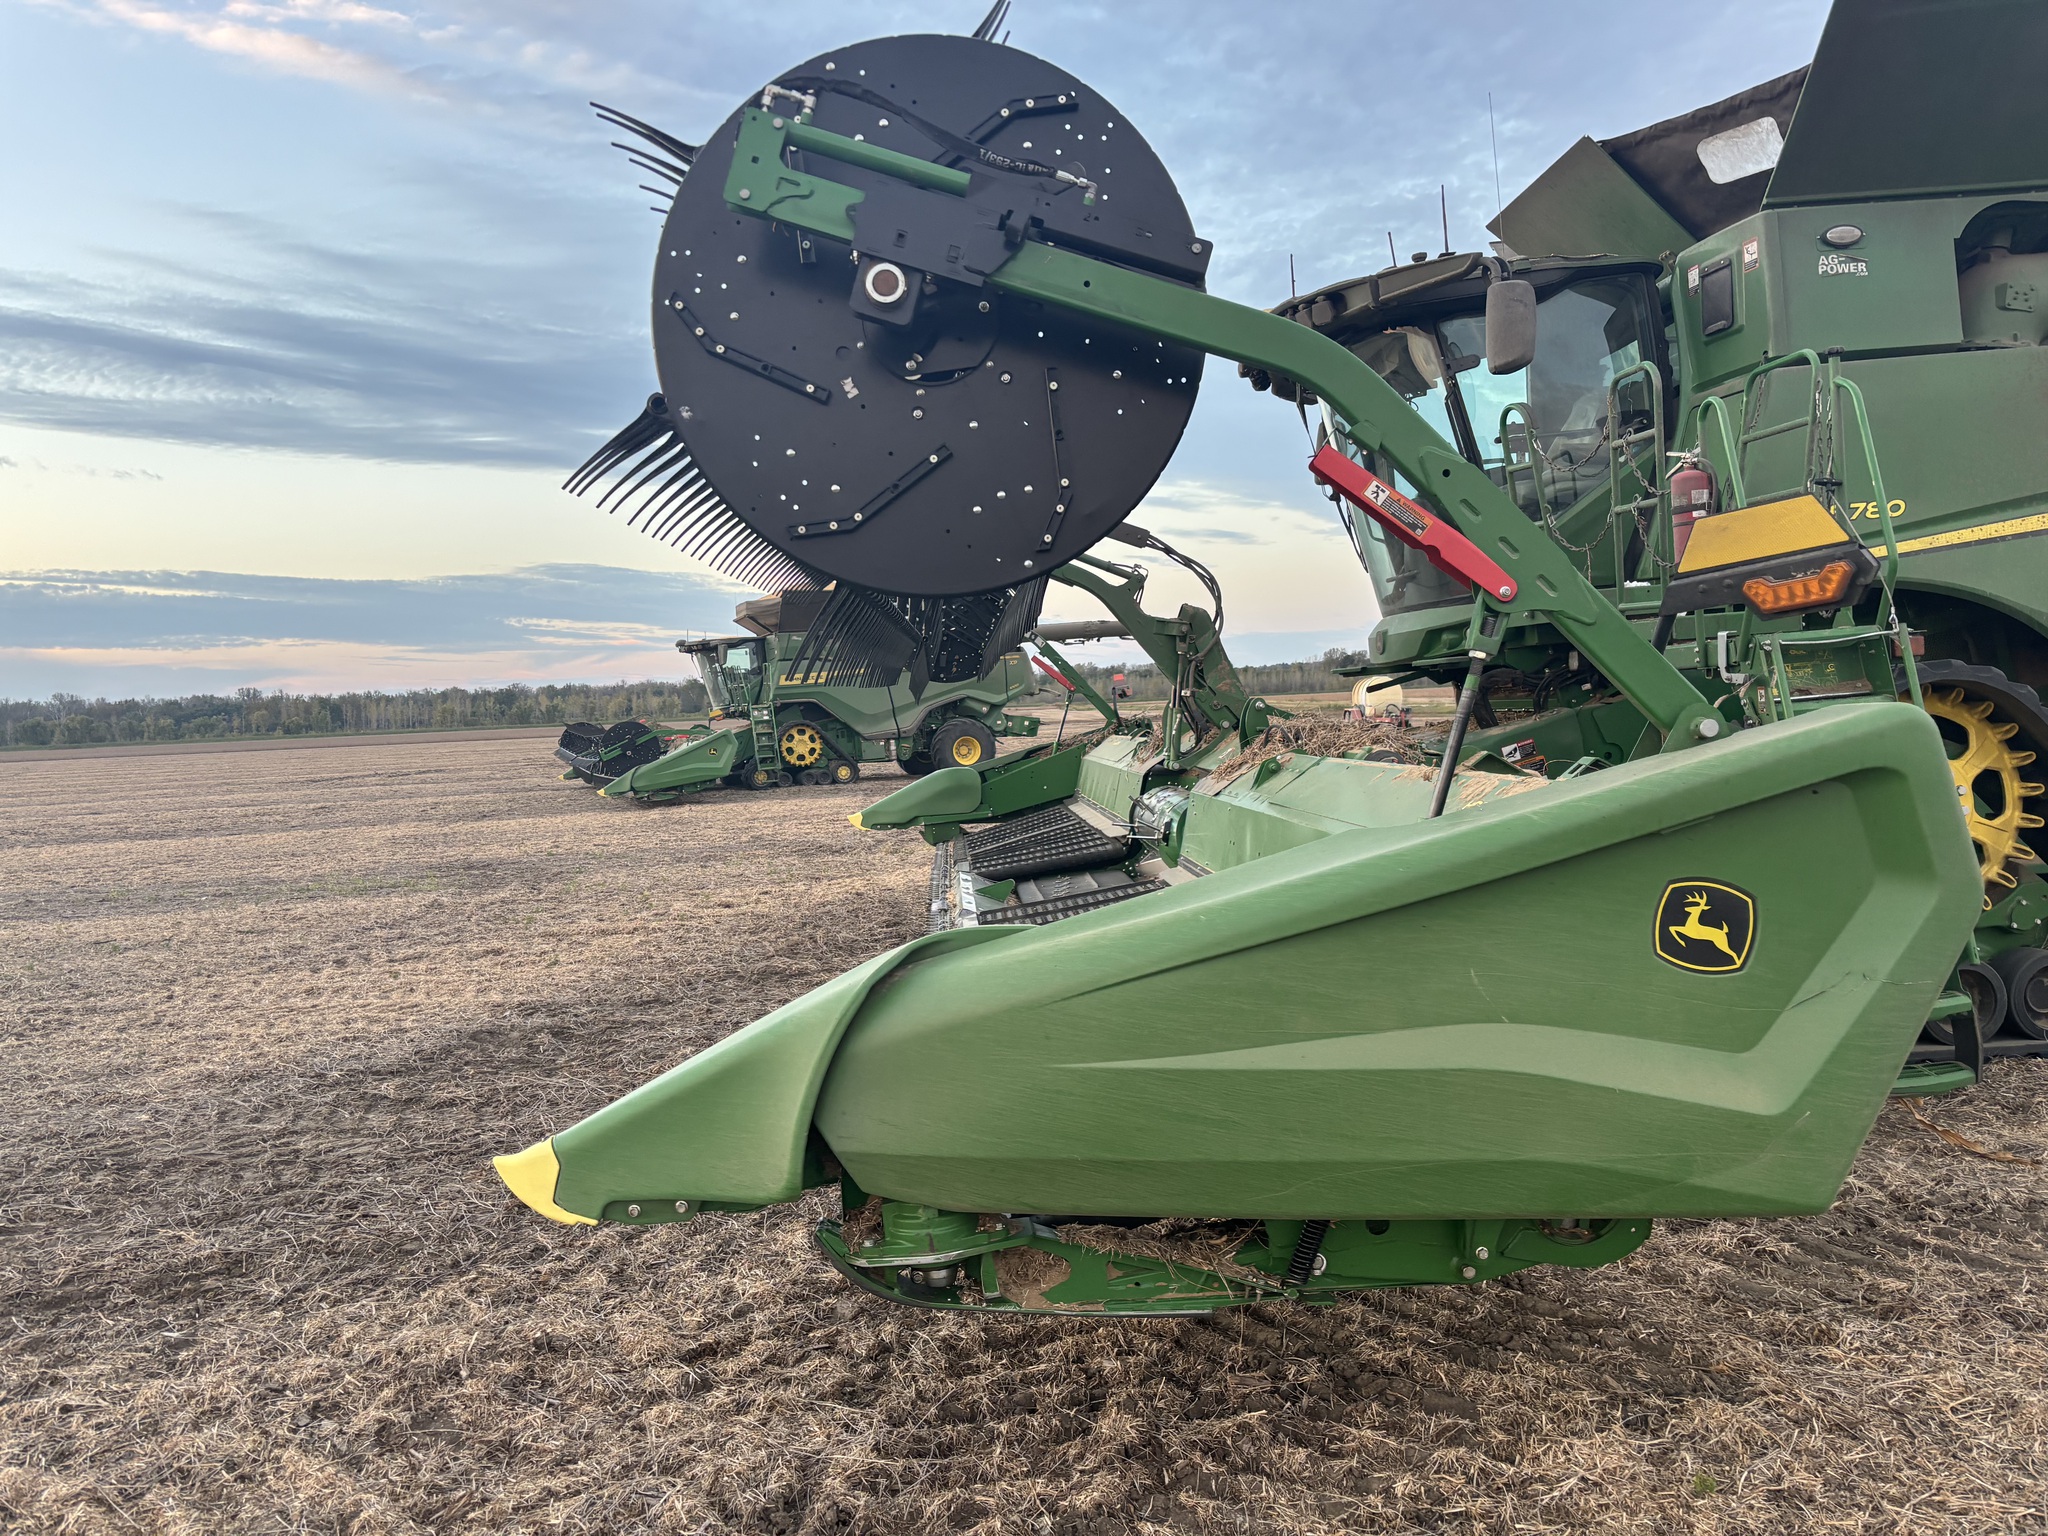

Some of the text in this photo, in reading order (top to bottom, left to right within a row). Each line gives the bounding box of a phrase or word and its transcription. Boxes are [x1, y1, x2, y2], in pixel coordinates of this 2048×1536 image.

[1818, 254, 1846, 266] AG-
[1818, 262, 1868, 275] POWER
[1402, 502, 1426, 521] WARNING
[1829, 499, 1907, 521] 780
